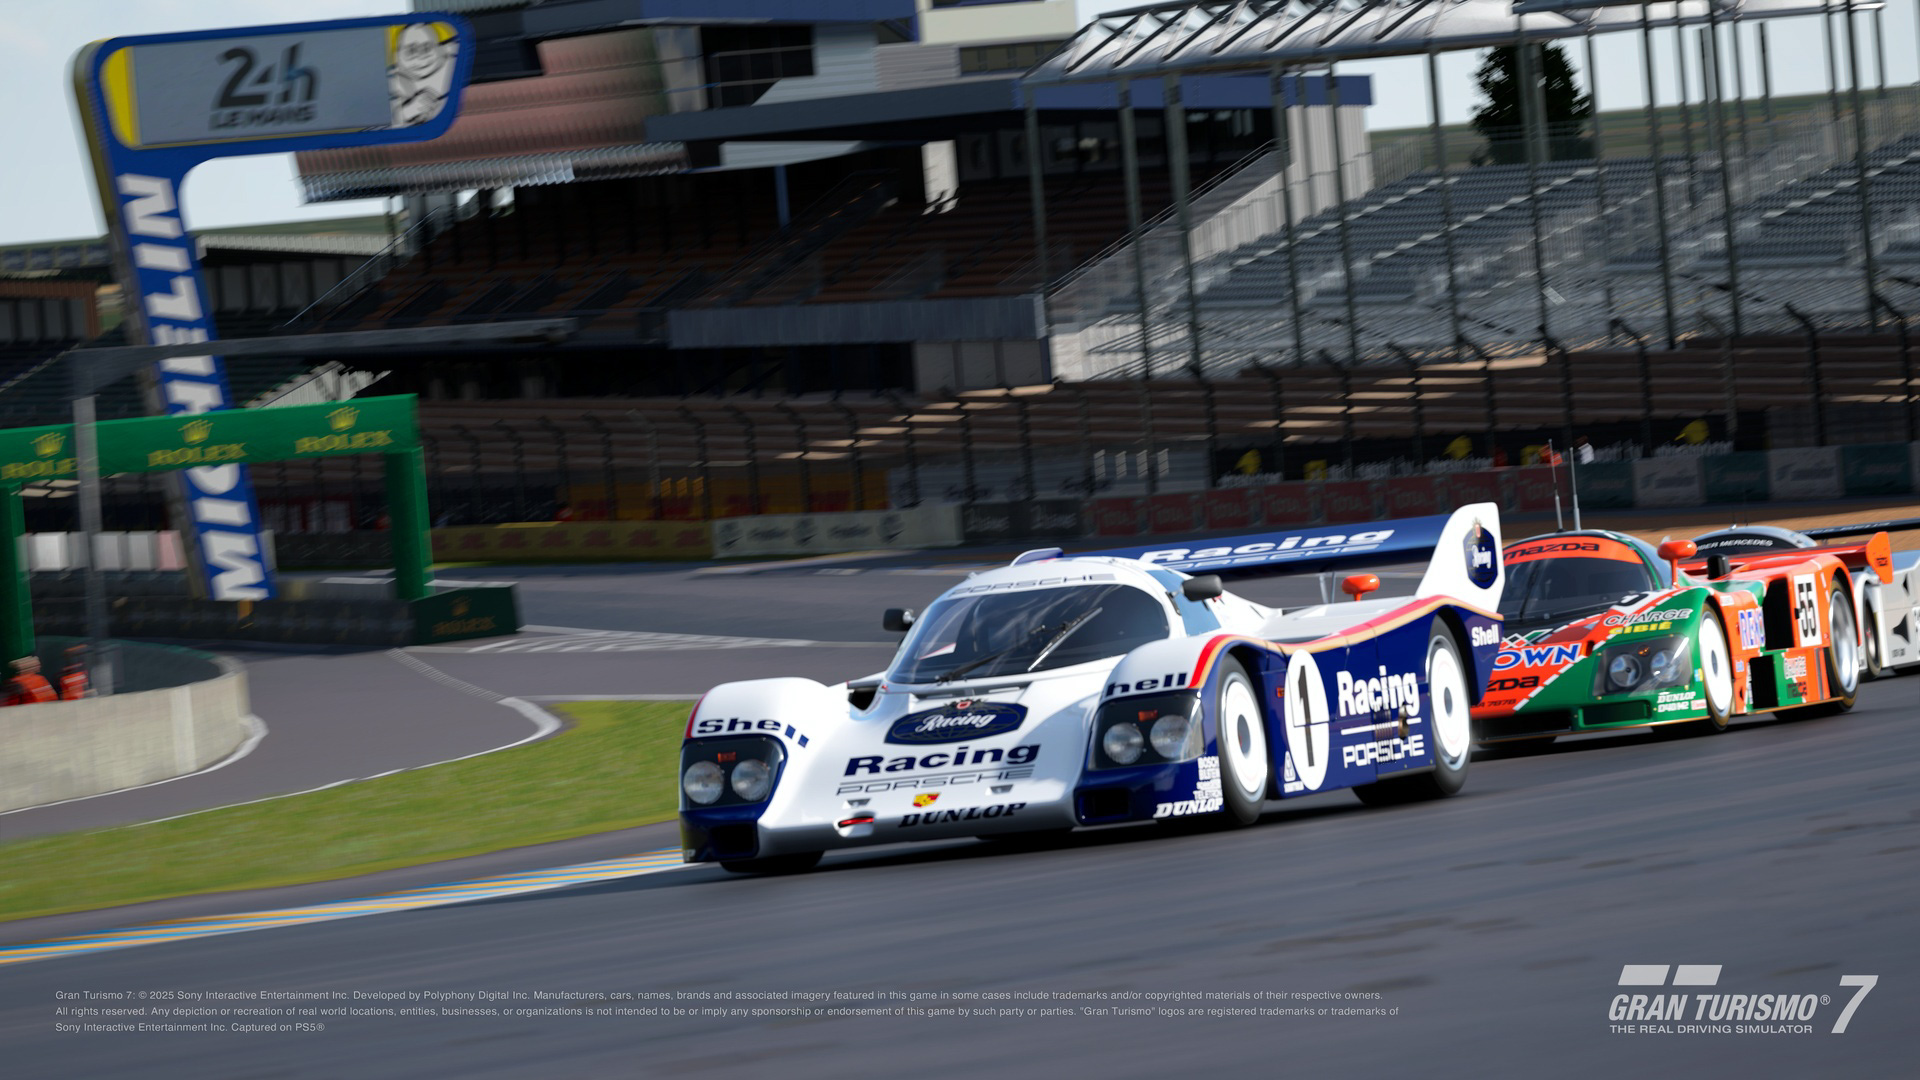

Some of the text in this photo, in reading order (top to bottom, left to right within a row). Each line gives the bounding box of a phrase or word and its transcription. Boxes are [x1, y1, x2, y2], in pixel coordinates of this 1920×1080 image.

[209, 104, 318, 131] LE MANS
[148, 443, 248, 467] ROLEX
[294, 430, 394, 454] ROLEX
[2, 457, 80, 479] ROLE
[1140, 529, 1395, 563] Racing
[1719, 538, 1774, 548] MERCEDES
[948, 573, 1116, 597] PORSCHE
[1603, 608, 1694, 628] CHARGE
[1798, 582, 1817, 638] 55
[1471, 624, 1499, 647] Shell
[1492, 643, 1582, 671] OWN
[1337, 665, 1421, 717] Racing
[1656, 691, 1697, 704] DUNLOP
[914, 712, 997, 733] Racing
[1298, 665, 1315, 767] 1
[697, 717, 810, 748] Shell
[843, 744, 1042, 777] Racing
[1342, 734, 1425, 768] PORSCHE
[836, 768, 1035, 796] PORSCHE
[898, 802, 1028, 828] DUNLOP
[1153, 798, 1224, 819] DUNLOP
